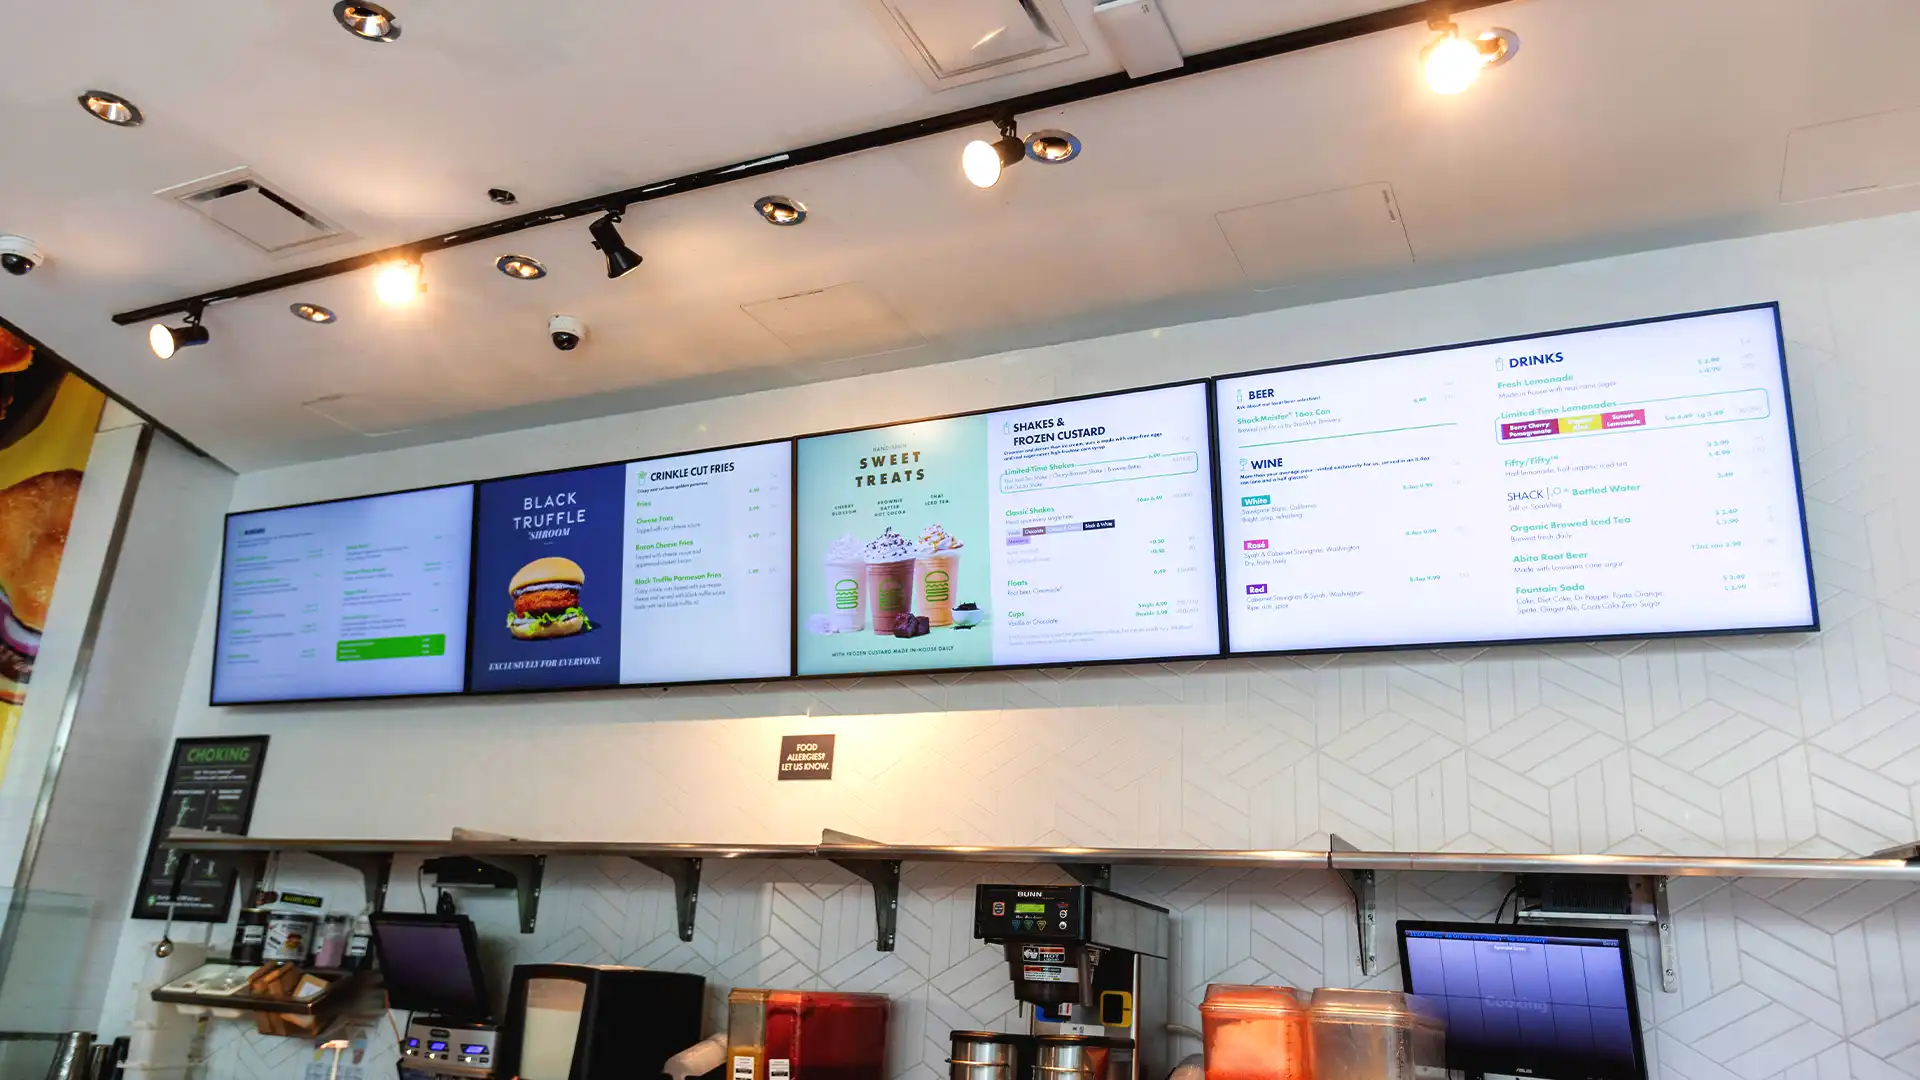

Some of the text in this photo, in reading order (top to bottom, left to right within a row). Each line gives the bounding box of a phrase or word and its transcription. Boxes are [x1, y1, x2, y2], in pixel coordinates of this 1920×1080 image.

[1509, 352, 1564, 368] DRINKS
[1498, 374, 1574, 389] Fresh Lemonade
[1249, 389, 1274, 400] BEER
[1501, 400, 1616, 419] Limited-Time Lemonades
[1014, 418, 1065, 432] SHAKES &
[1014, 427, 1105, 446] FROZEN CUSTARD
[1510, 429, 1552, 438] Pomegranate
[860, 451, 920, 469] SWEET
[1251, 457, 1283, 470] WINE
[651, 462, 734, 481] CRINKLE CUT FRIES
[1005, 461, 1074, 476] Limited-Time Shakes
[855, 469, 924, 488] TREATS
[1572, 486, 1607, 495] Bottled
[524, 492, 576, 510] BLACK
[1244, 498, 1268, 506] White
[1029, 506, 1055, 514] Shakes
[513, 510, 586, 530] TRUFFLE
[1510, 522, 1548, 533] Organic
[1551, 519, 1588, 529] Brewed
[1591, 517, 1610, 525] Iced
[528, 528, 571, 540] 'SHROOM
[1556, 532, 1572, 540] daily
[1248, 541, 1266, 549] Rosé
[1326, 544, 1359, 554] Washington
[1513, 554, 1538, 563] Abita
[674, 573, 705, 581] Parmesan
[1329, 590, 1362, 598] Washington
[1516, 583, 1585, 594] Fountain Soda
[1640, 600, 1660, 608] Sugar
[488, 656, 601, 671] EXCLUSIVELY FOR EVERYONE
[796, 743, 818, 751] FOOD
[187, 747, 251, 762] CHOKING
[786, 752, 826, 761] ALLERGIES?
[782, 763, 792, 771] LET
[804, 762, 829, 770] KNOW.
[1486, 995, 1548, 1014] Cooking
